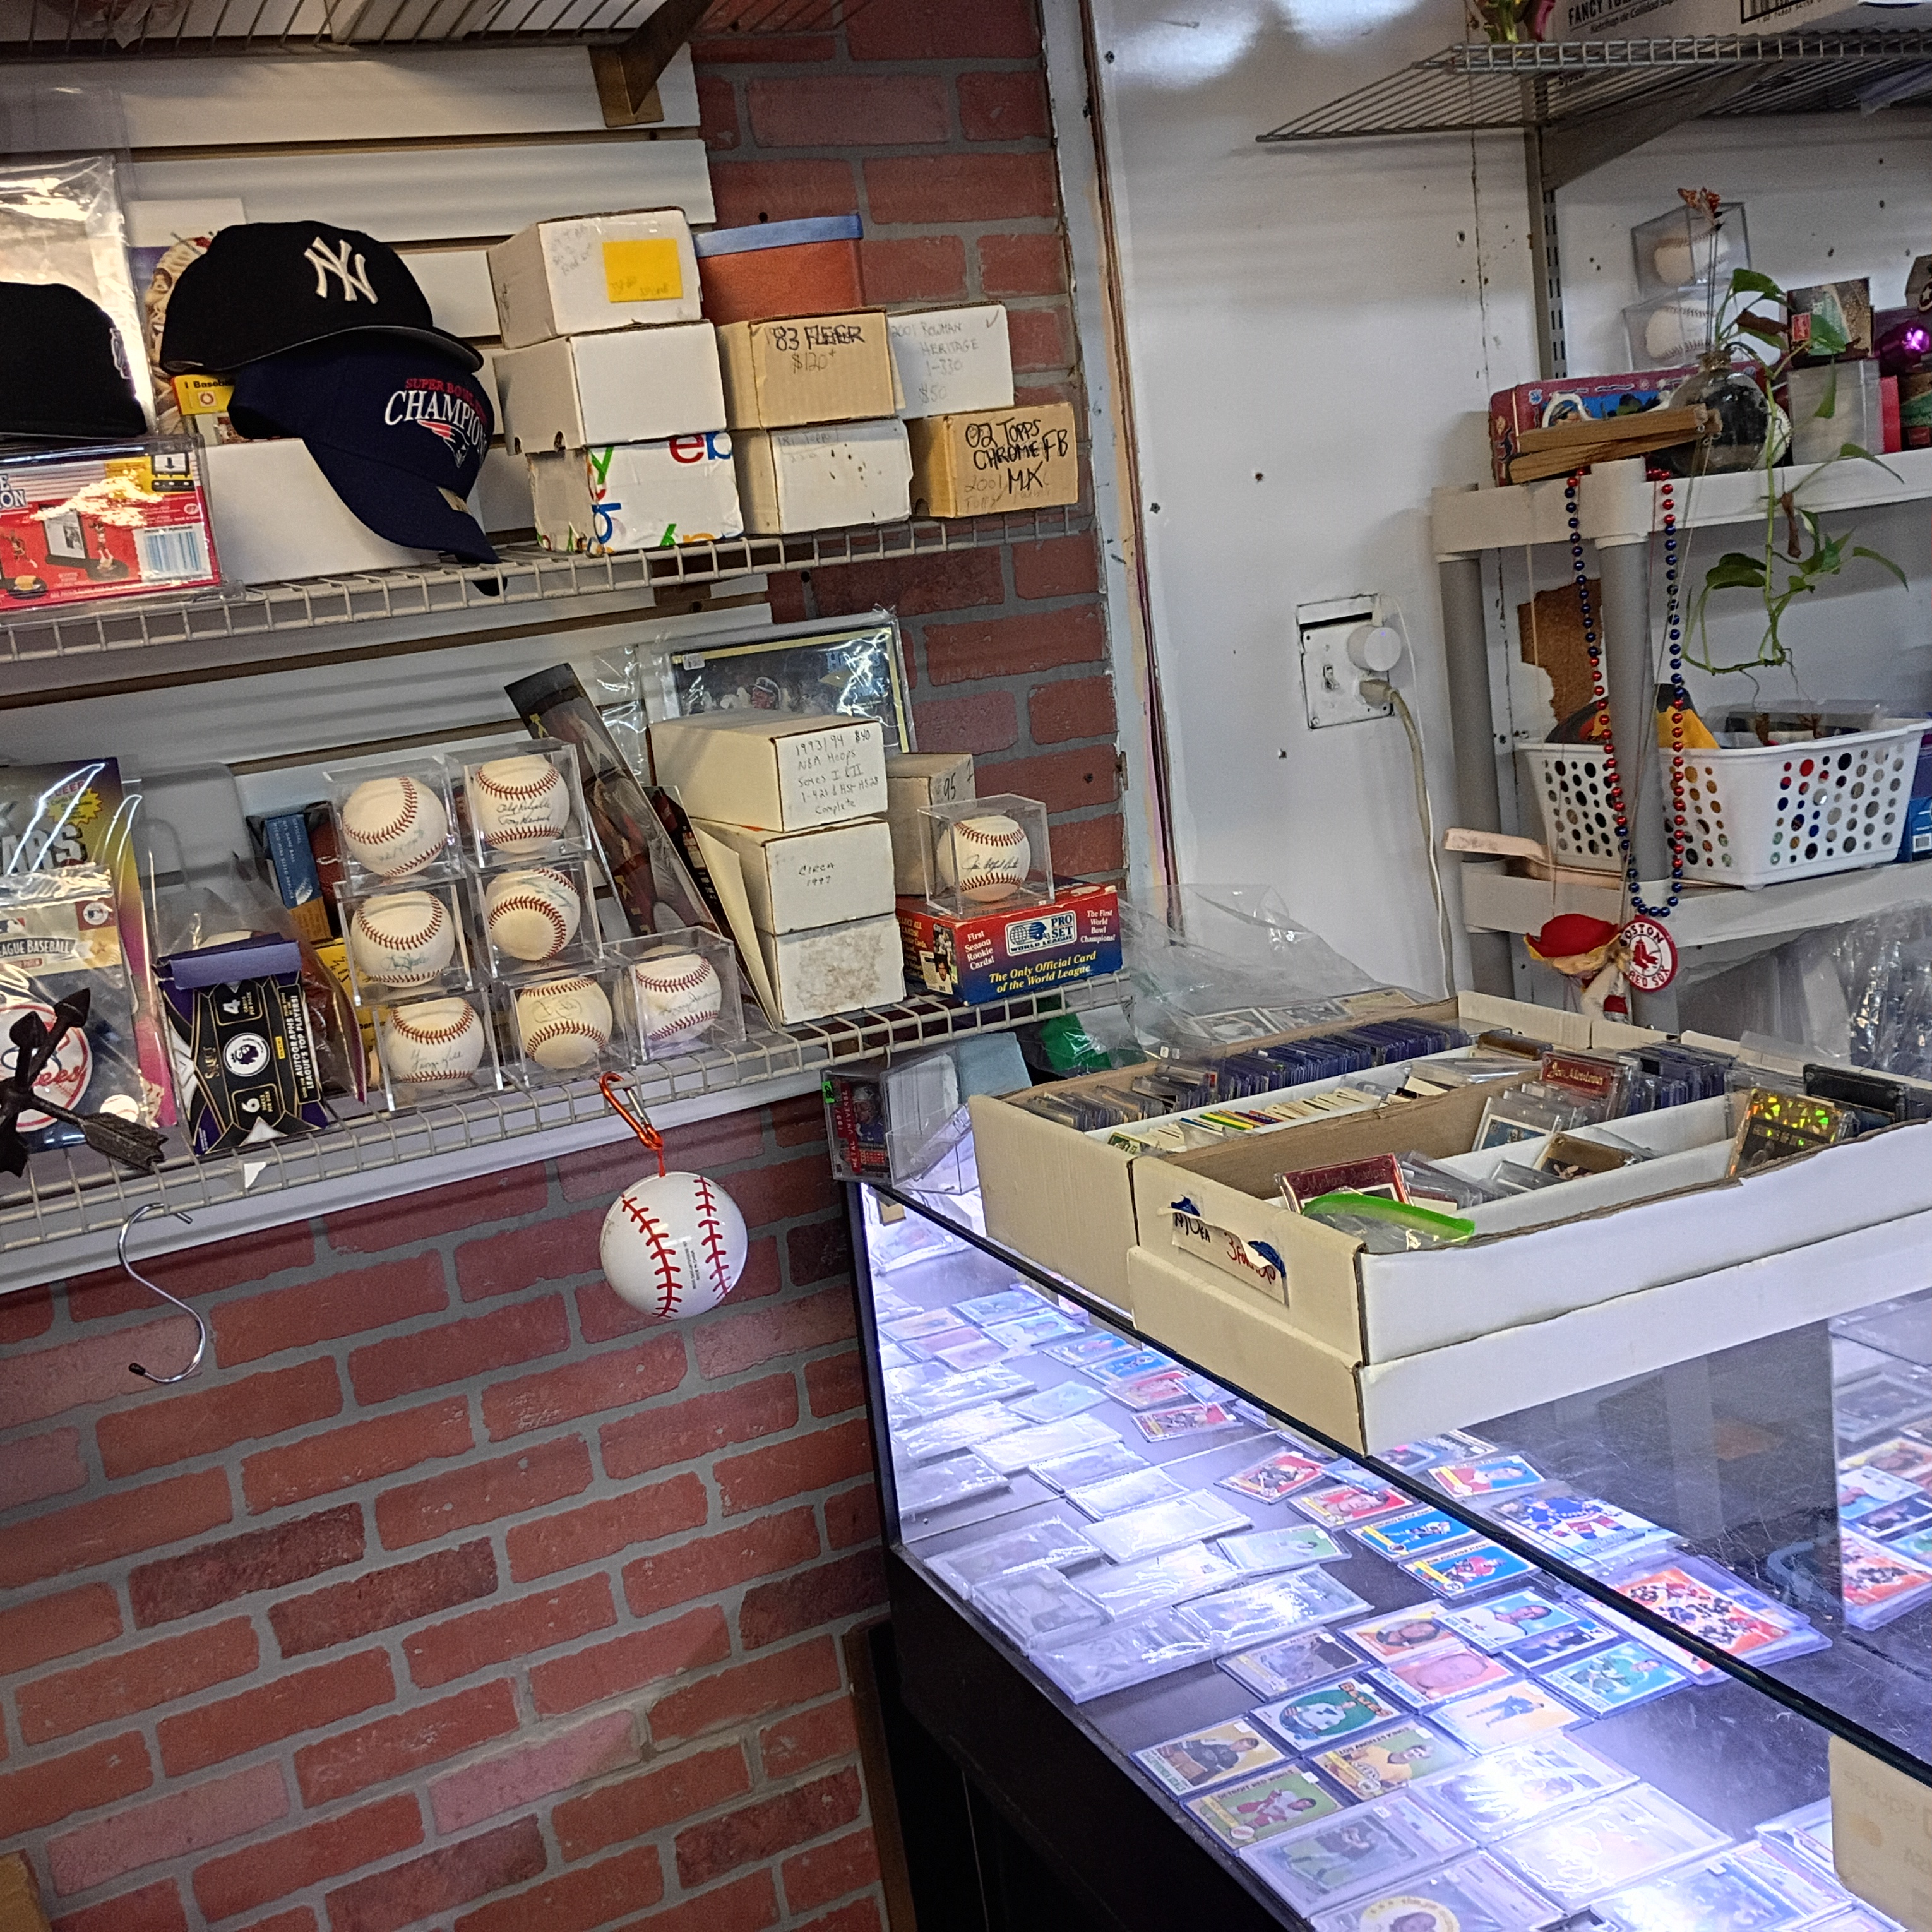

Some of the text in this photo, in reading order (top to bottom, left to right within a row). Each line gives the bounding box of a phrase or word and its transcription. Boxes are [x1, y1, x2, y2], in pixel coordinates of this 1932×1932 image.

[1568, 1, 1602, 25] FANCY
[304, 237, 378, 304] NY
[804, 325, 866, 350] FLEER
[919, 338, 979, 356] HERITAGE
[405, 378, 445, 391] SUPER
[918, 383, 948, 406] $50
[996, 419, 1041, 446] TOPPS
[973, 440, 1040, 470] CHROME
[798, 756, 821, 770] NBA
[943, 772, 956, 801] 95
[815, 797, 857, 816] Complete
[799, 861, 835, 876] CIRCA
[1051, 915, 1073, 927] PRO
[967, 930, 985, 941] First
[1052, 926, 1073, 938] SET
[1080, 934, 1116, 943] Champions!
[1619, 923, 1664, 947] BOSTON
[27, 939, 70, 954] BASEBALL
[965, 939, 991, 953] Season
[1010, 935, 1073, 952] WORLD LEAGUE
[967, 948, 994, 962] Rookie
[970, 955, 995, 970] Cards!
[989, 950, 1097, 984] The Only Official Card
[1628, 965, 1671, 987] RED SOX
[996, 964, 1091, 994] of the World League
[223, 999, 241, 1015] 4
[286, 1017, 304, 1077] AUTOGRAPHS
[291, 995, 315, 1090] LEAGUE'S TOP PLAYERS!
[33, 1066, 81, 1087] ees
[241, 1097, 261, 1113] 6
[841, 1090, 855, 1135] UNIVERSE
[835, 1110, 844, 1130] 1997
